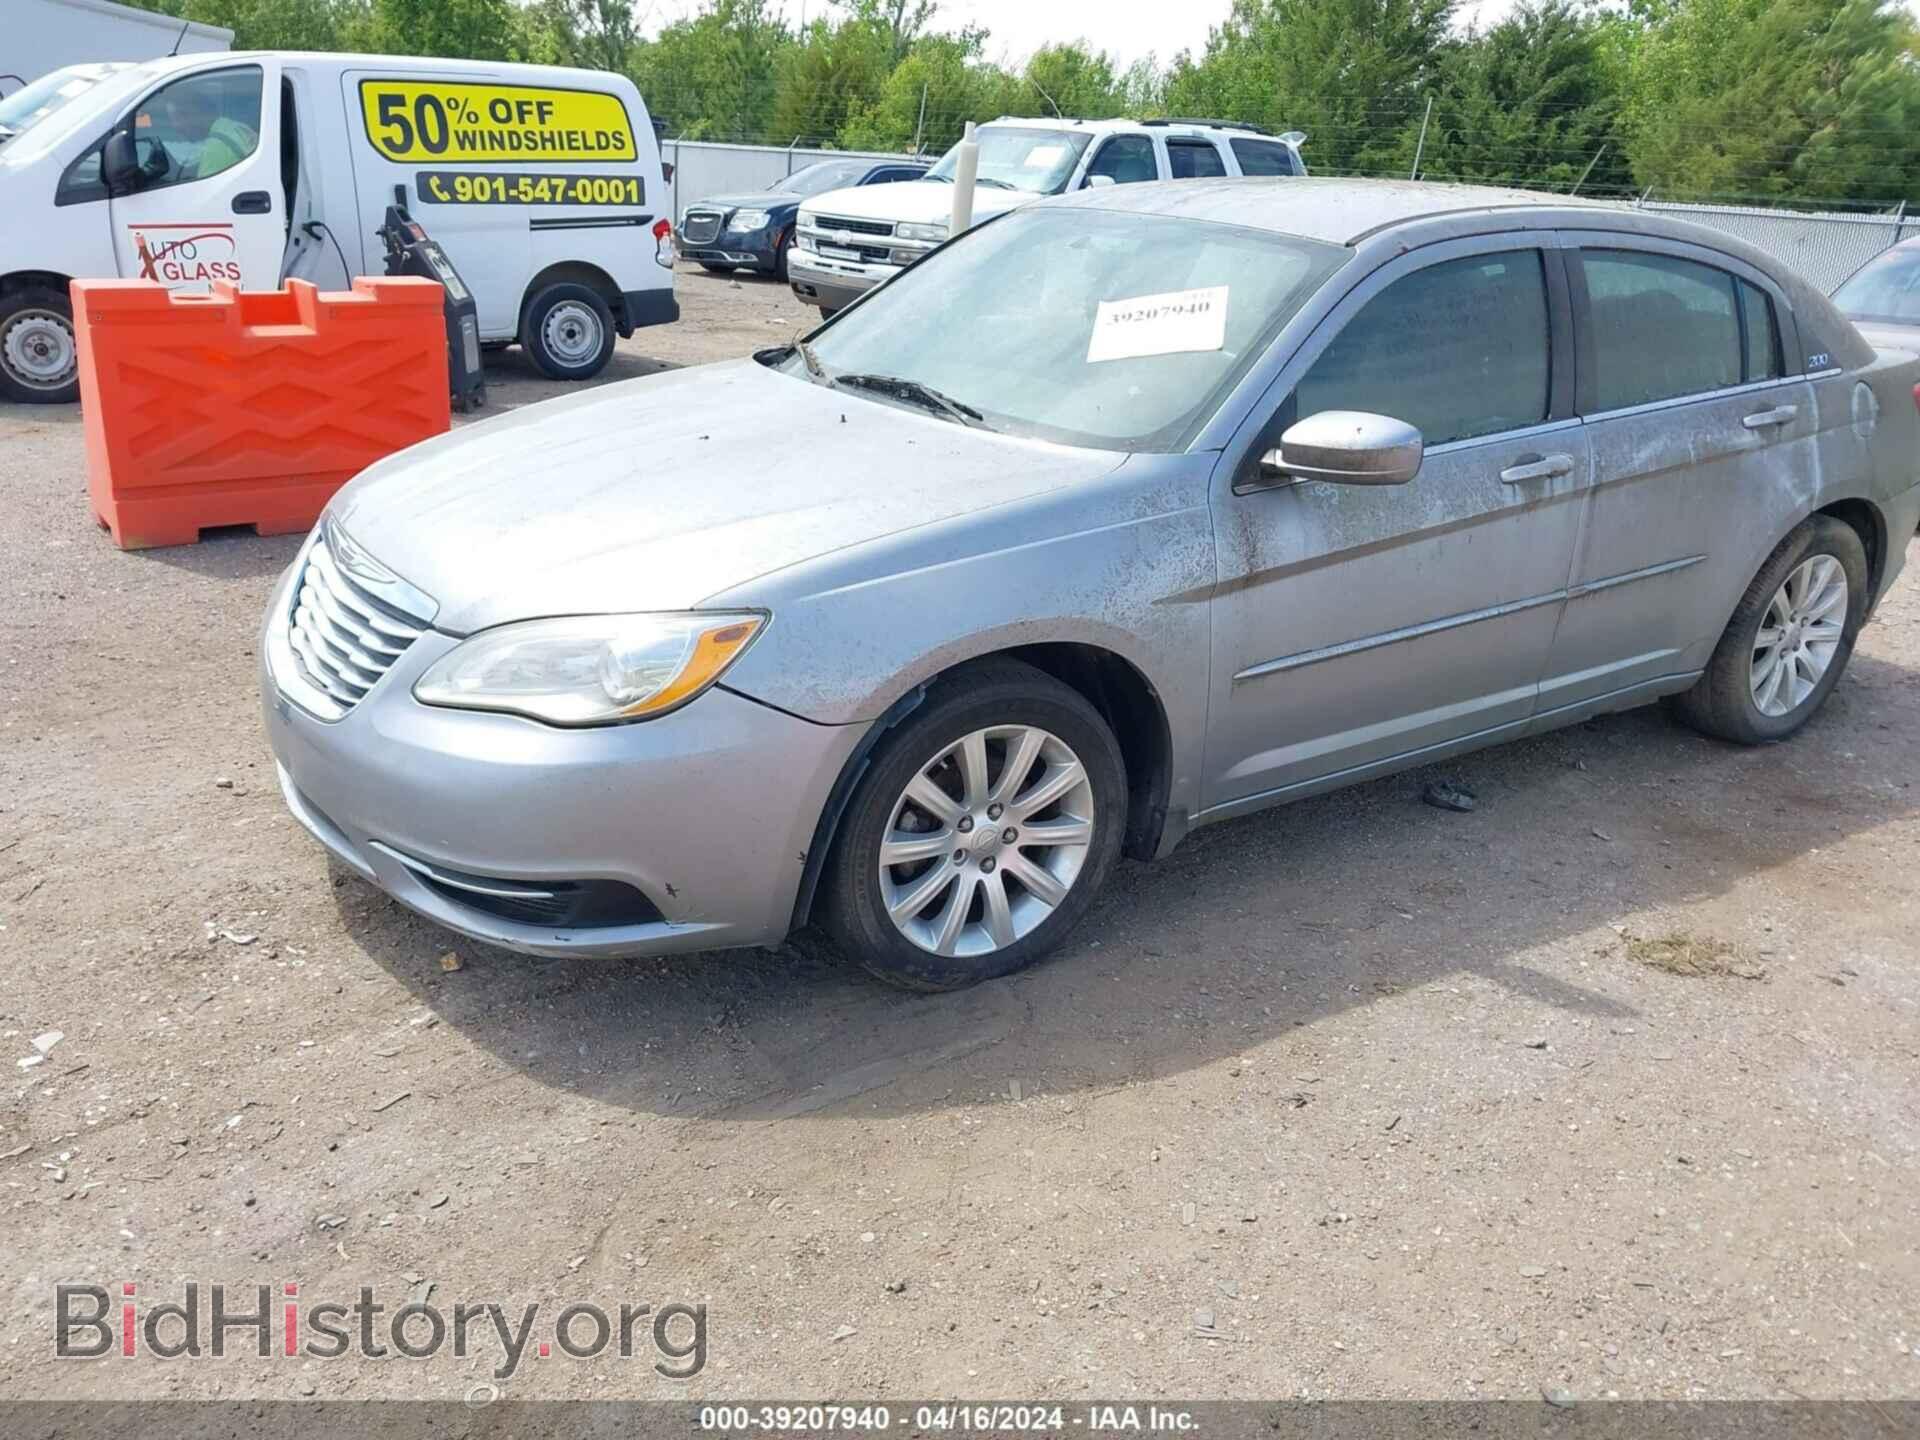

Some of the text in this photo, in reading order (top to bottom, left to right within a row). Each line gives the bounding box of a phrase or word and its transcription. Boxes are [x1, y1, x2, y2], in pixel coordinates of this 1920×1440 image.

[378, 93, 553, 154] 50% OFF
[454, 129, 626, 151] WINDSHIELDS
[454, 175, 639, 204] 901-547-0001
[162, 261, 241, 281] GLASS
